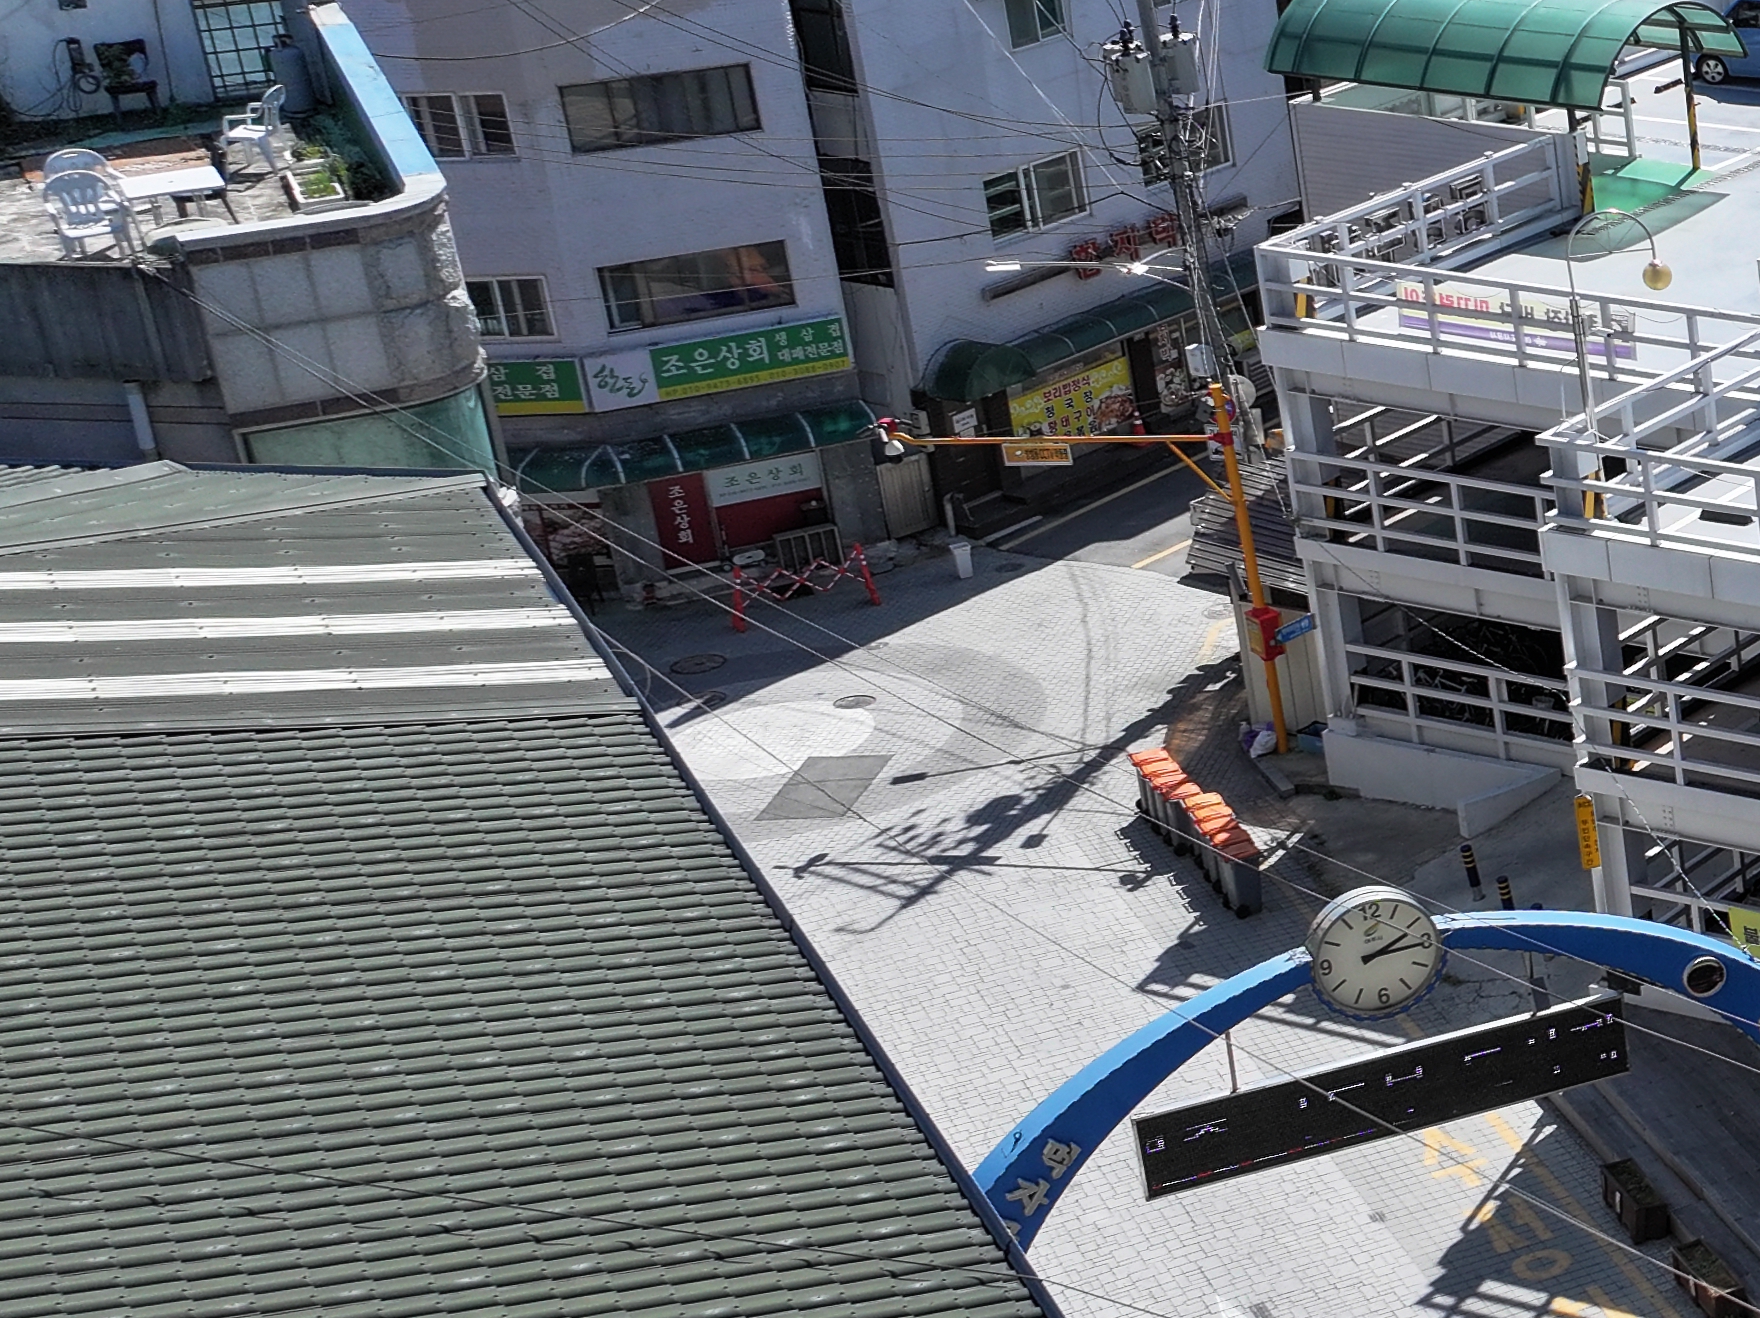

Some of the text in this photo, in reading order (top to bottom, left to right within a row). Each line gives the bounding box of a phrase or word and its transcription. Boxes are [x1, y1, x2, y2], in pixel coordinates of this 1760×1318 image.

[661, 337, 770, 378] 조은상회
[1042, 374, 1092, 404] 보리밥정식
[723, 463, 803, 489] 조은상회
[667, 484, 694, 545] 조은상회
[1358, 902, 1381, 921] 12
[1421, 932, 1432, 949] 3
[1320, 959, 1333, 976] 9
[1377, 987, 1390, 1005] 6
